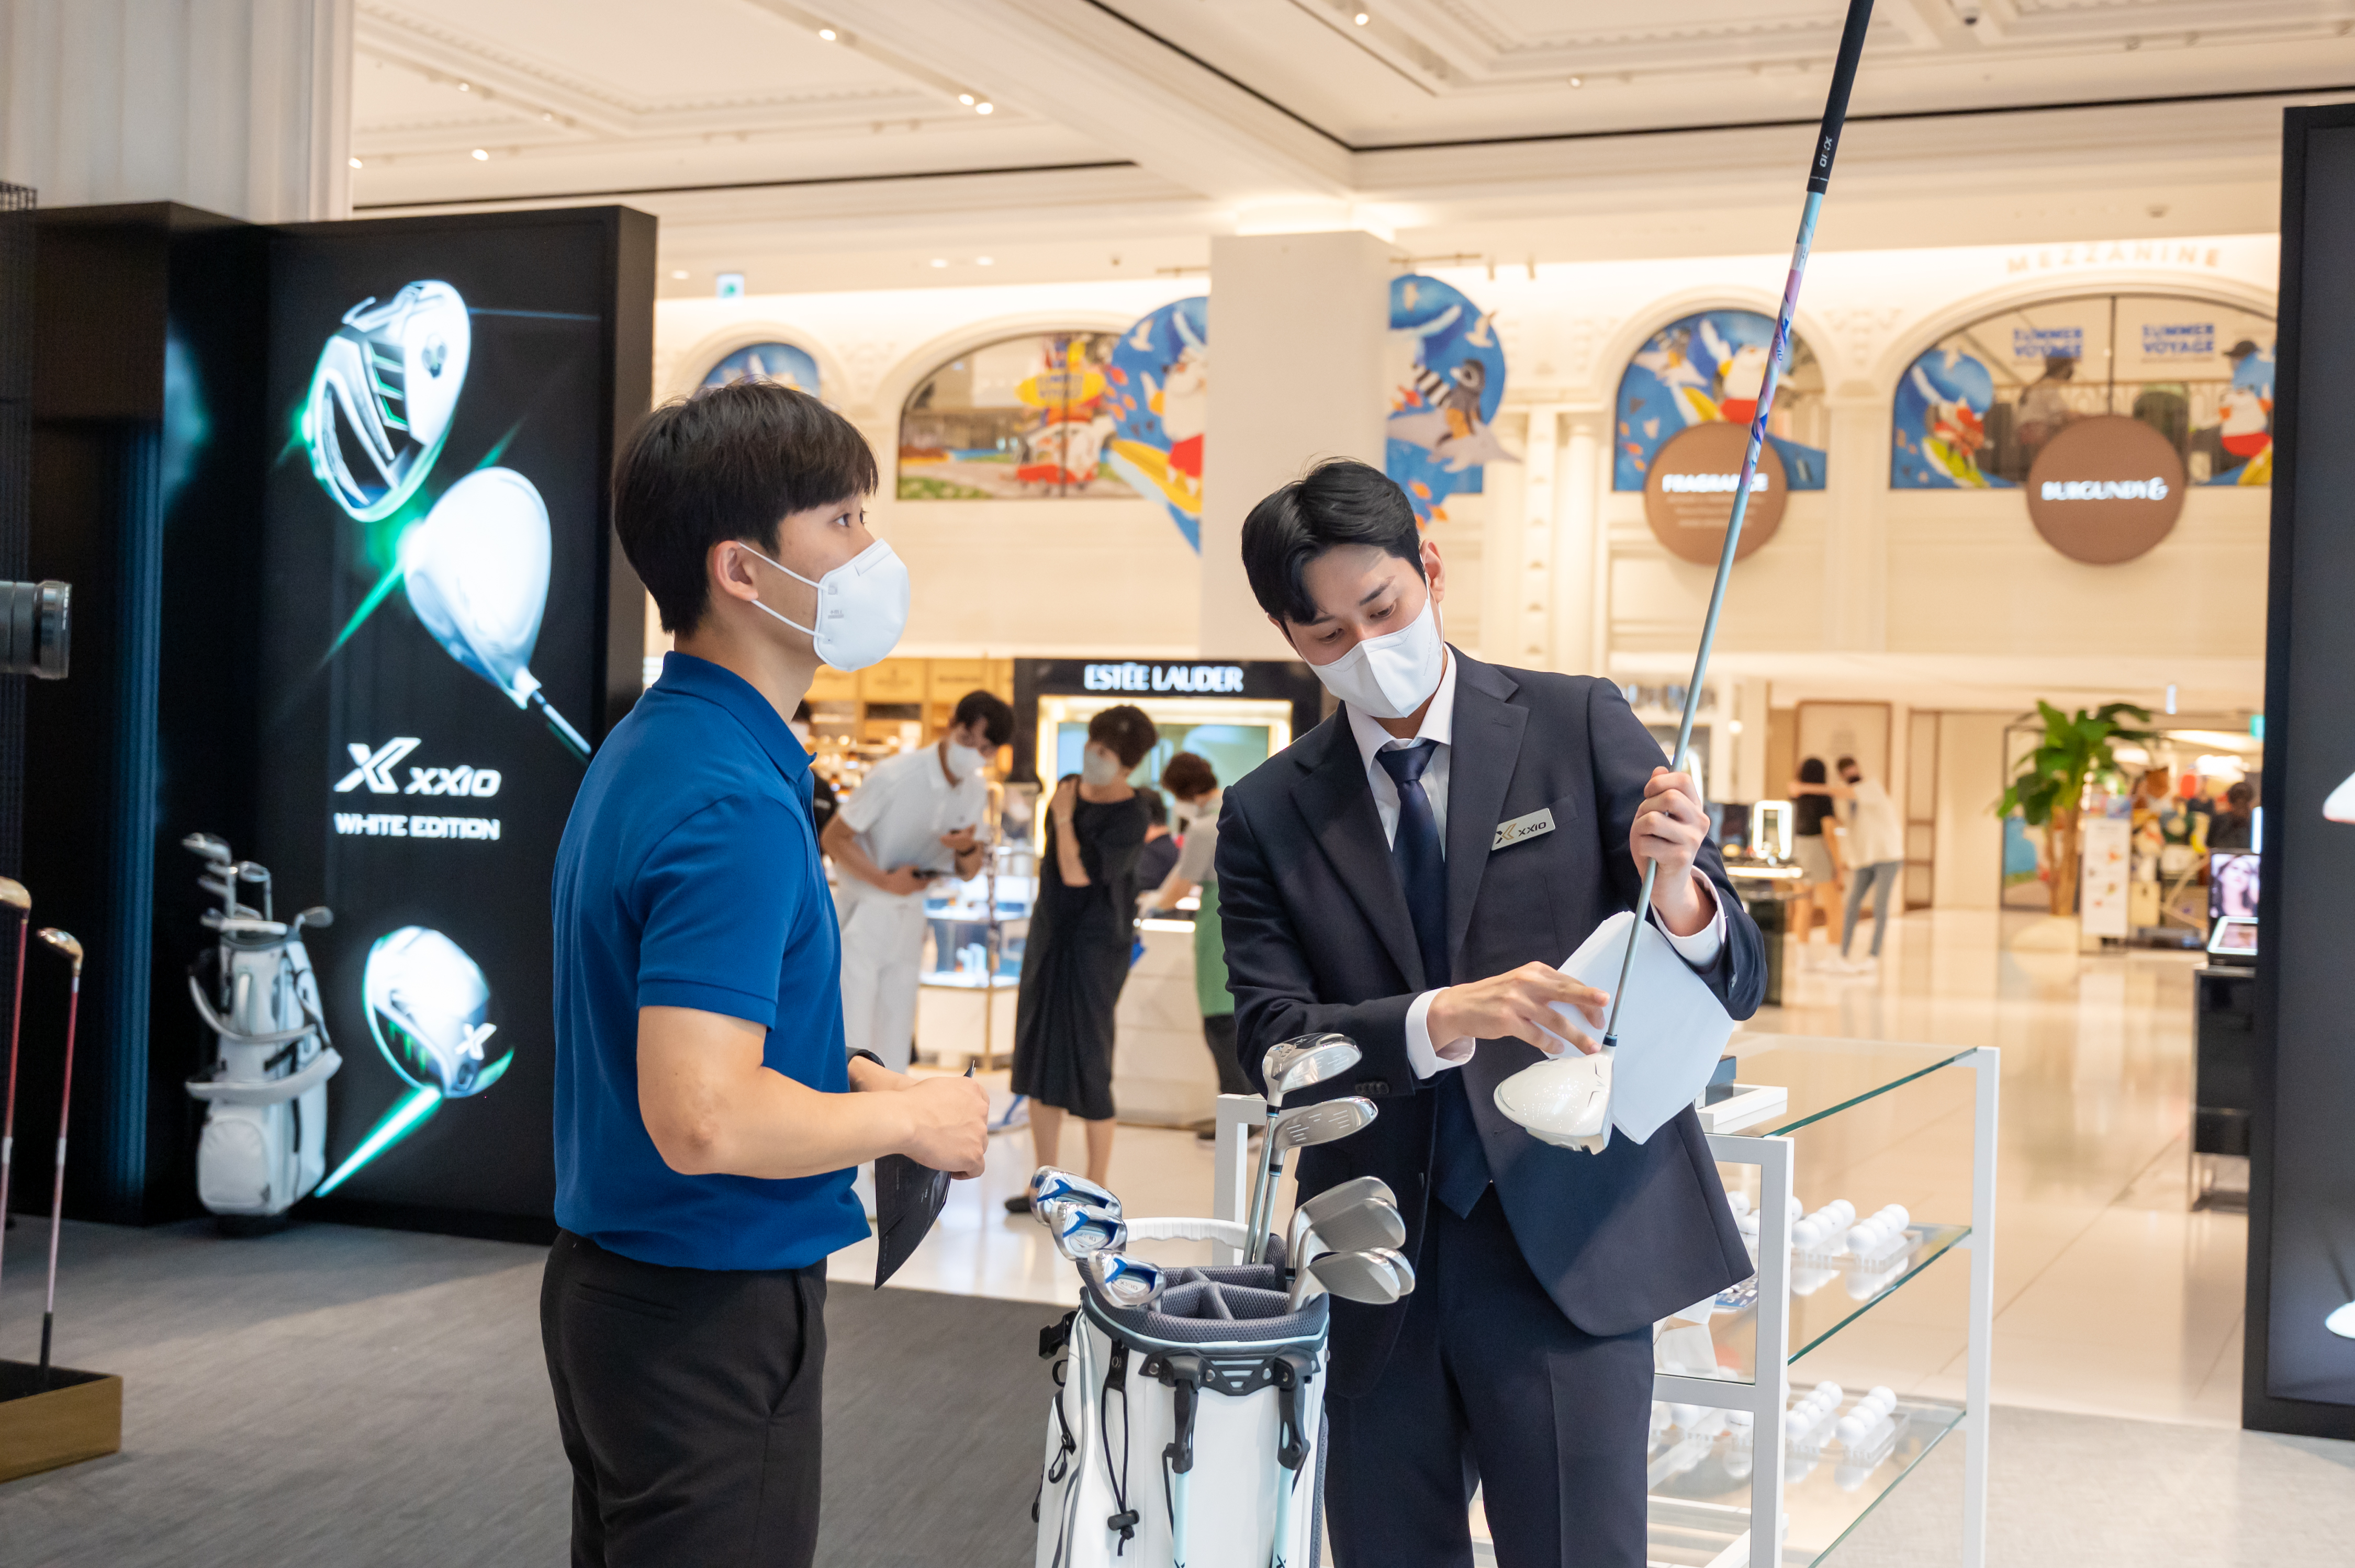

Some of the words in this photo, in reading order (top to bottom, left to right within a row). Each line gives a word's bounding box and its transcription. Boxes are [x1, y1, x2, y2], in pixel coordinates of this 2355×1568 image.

[2006, 241, 2219, 274] MEZZANINE
[2143, 323, 2214, 336] SUMMER
[2143, 340, 2214, 355] VOYAGE
[1152, 665, 1244, 692] LAUDER
[404, 765, 501, 797] XXIO
[333, 813, 408, 837] WHITE
[409, 816, 500, 840] EDITION
[1518, 822, 1546, 837] XXIO
